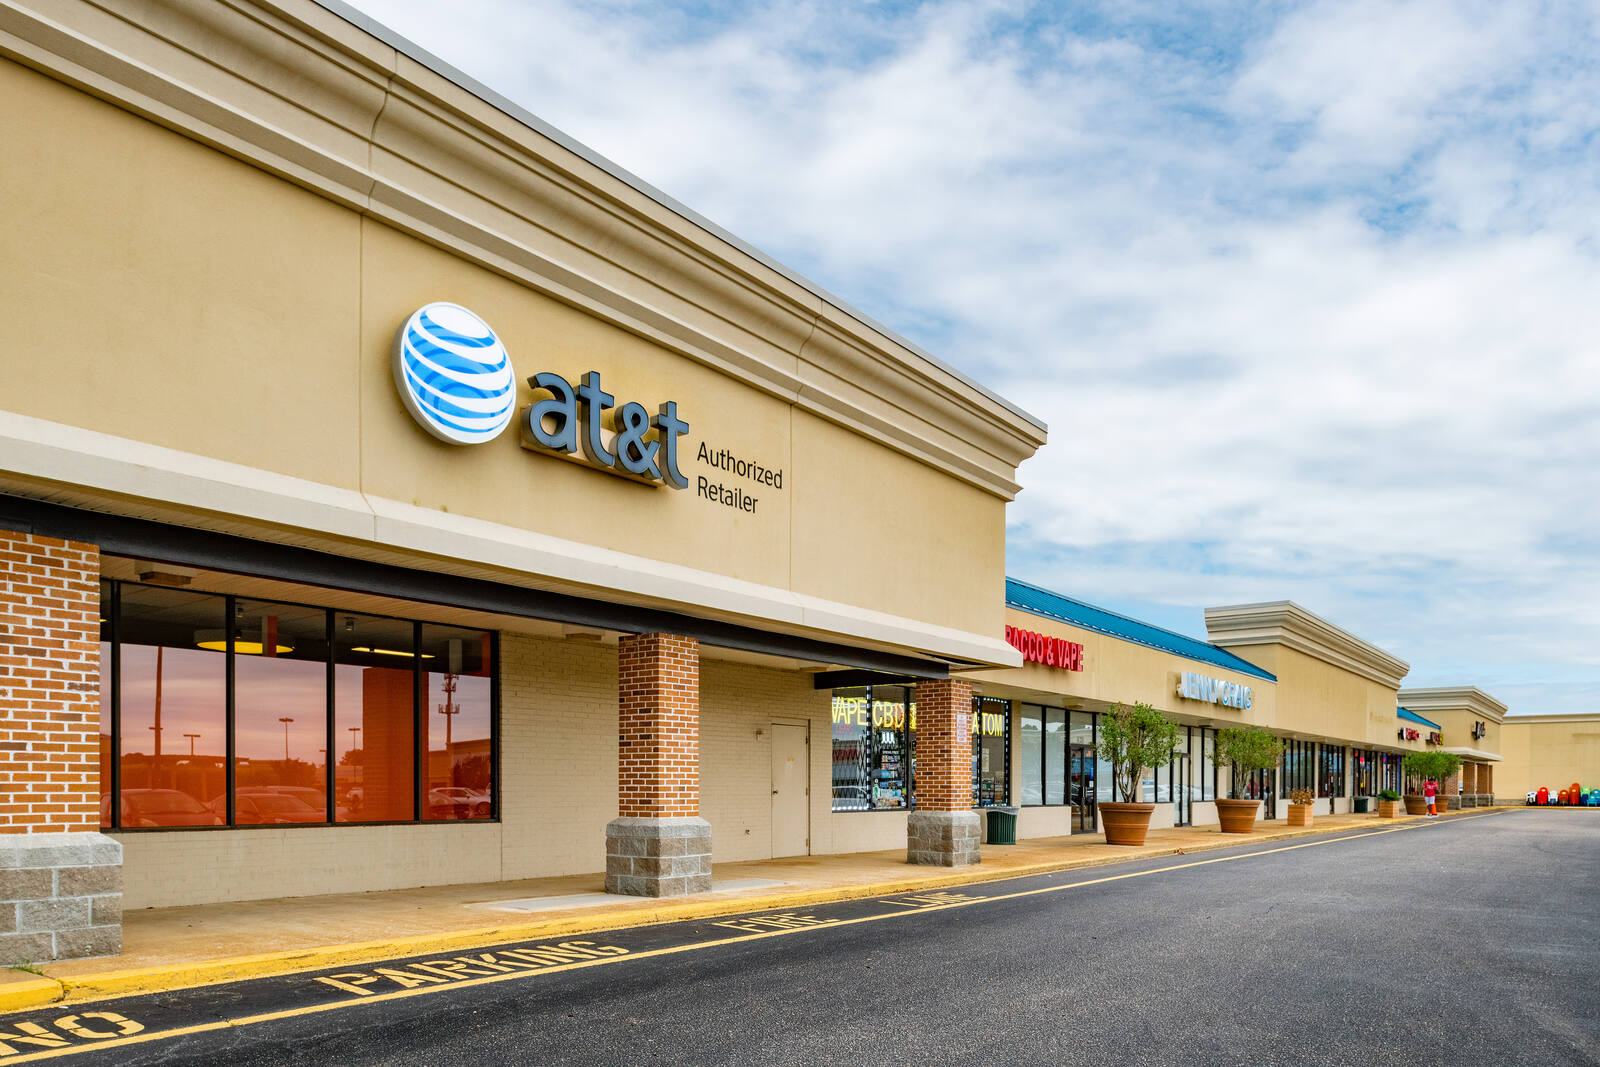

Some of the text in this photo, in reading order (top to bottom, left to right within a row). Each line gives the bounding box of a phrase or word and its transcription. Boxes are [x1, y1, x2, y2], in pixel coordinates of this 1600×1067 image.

[522, 370, 690, 490] at&t
[697, 442, 783, 490] Authorized
[698, 476, 759, 514] Retailer
[1046, 636, 1055, 666] &
[1057, 638, 1083, 672] VAPE
[1178, 671, 1252, 710] JENNY CRAIG
[832, 697, 867, 726] VAPE
[872, 700, 905, 729] CBD
[0, 1011, 146, 1057] NO
[312, 940, 630, 996] PARKING
[710, 912, 841, 933] FIRE
